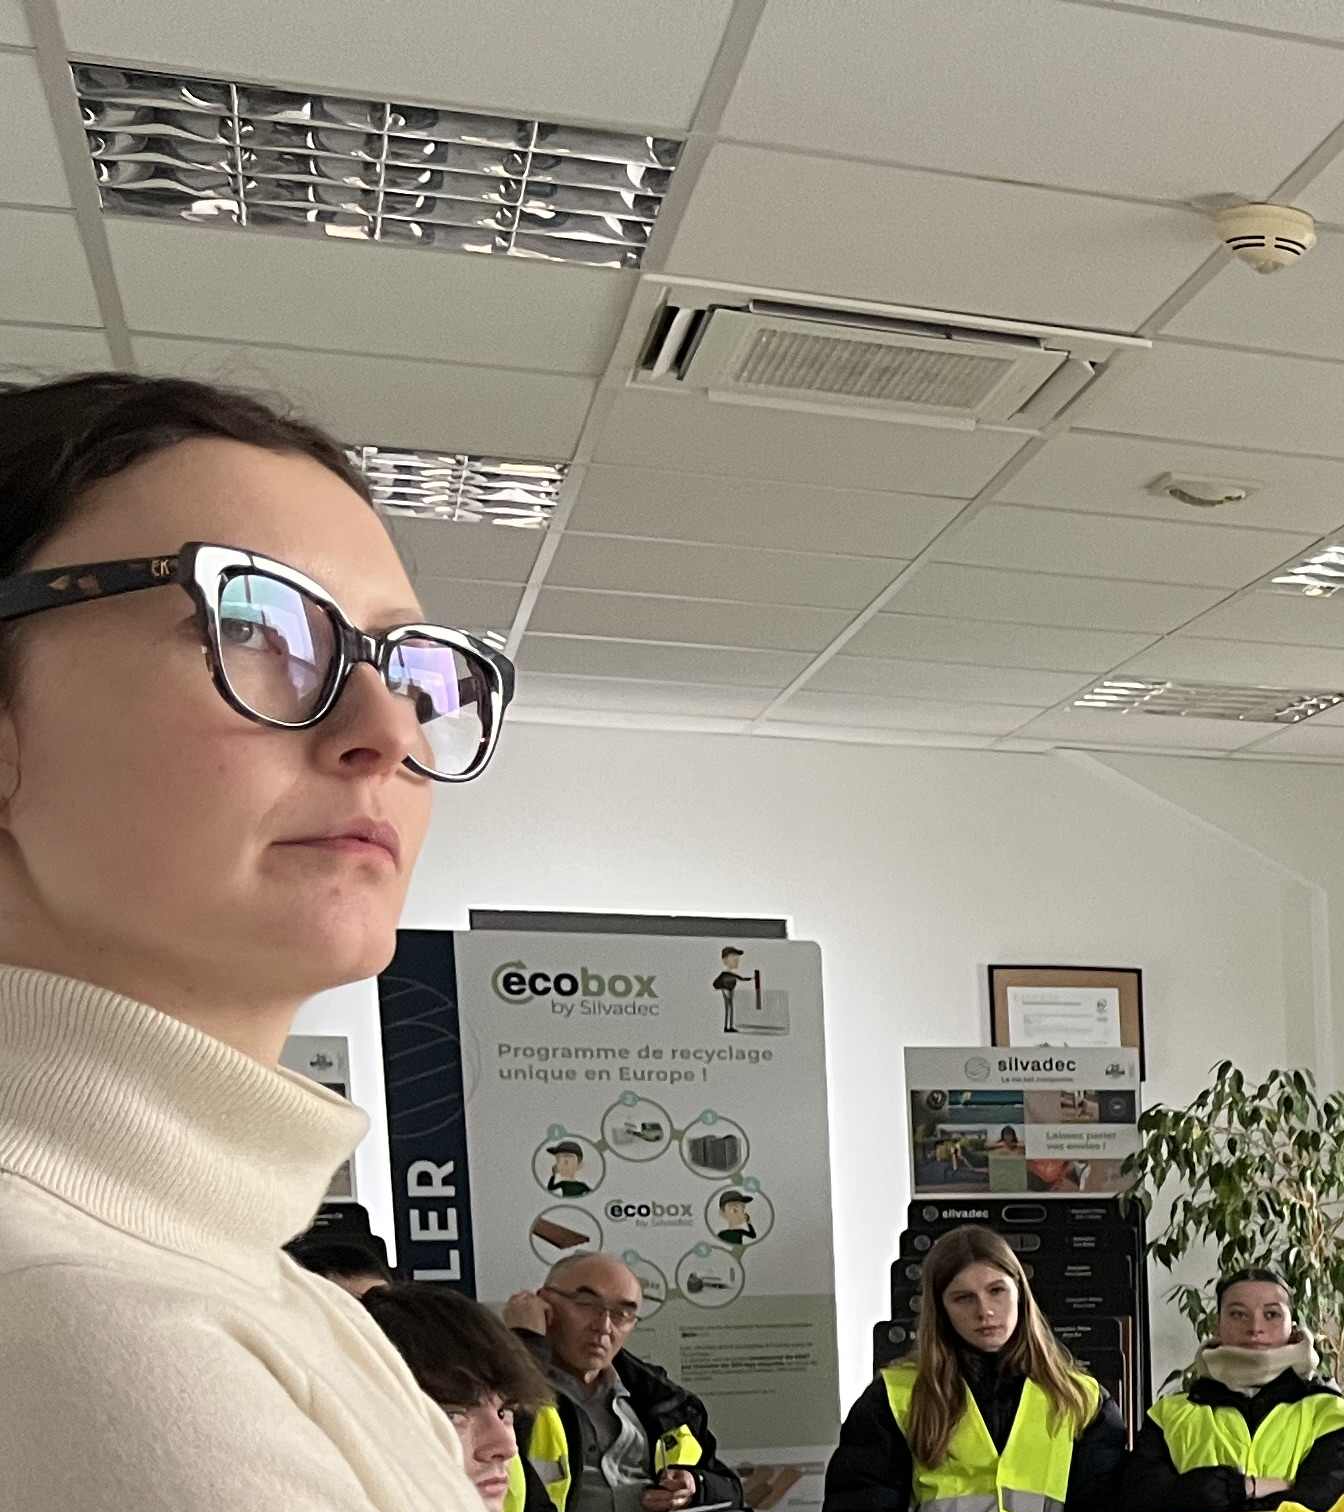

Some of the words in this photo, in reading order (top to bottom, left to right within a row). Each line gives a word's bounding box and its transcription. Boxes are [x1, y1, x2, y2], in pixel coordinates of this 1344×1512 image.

[502, 966, 659, 999] ecobox
[551, 1000, 575, 1018] by
[580, 1000, 661, 1017] Silvadec
[498, 1042, 630, 1062] Programme
[637, 1044, 663, 1060] de
[671, 1045, 774, 1065] recyclage
[499, 1064, 577, 1084] unique
[585, 1068, 611, 1082] en
[618, 1066, 696, 1085] Europe
[997, 1057, 1077, 1072] silvadec
